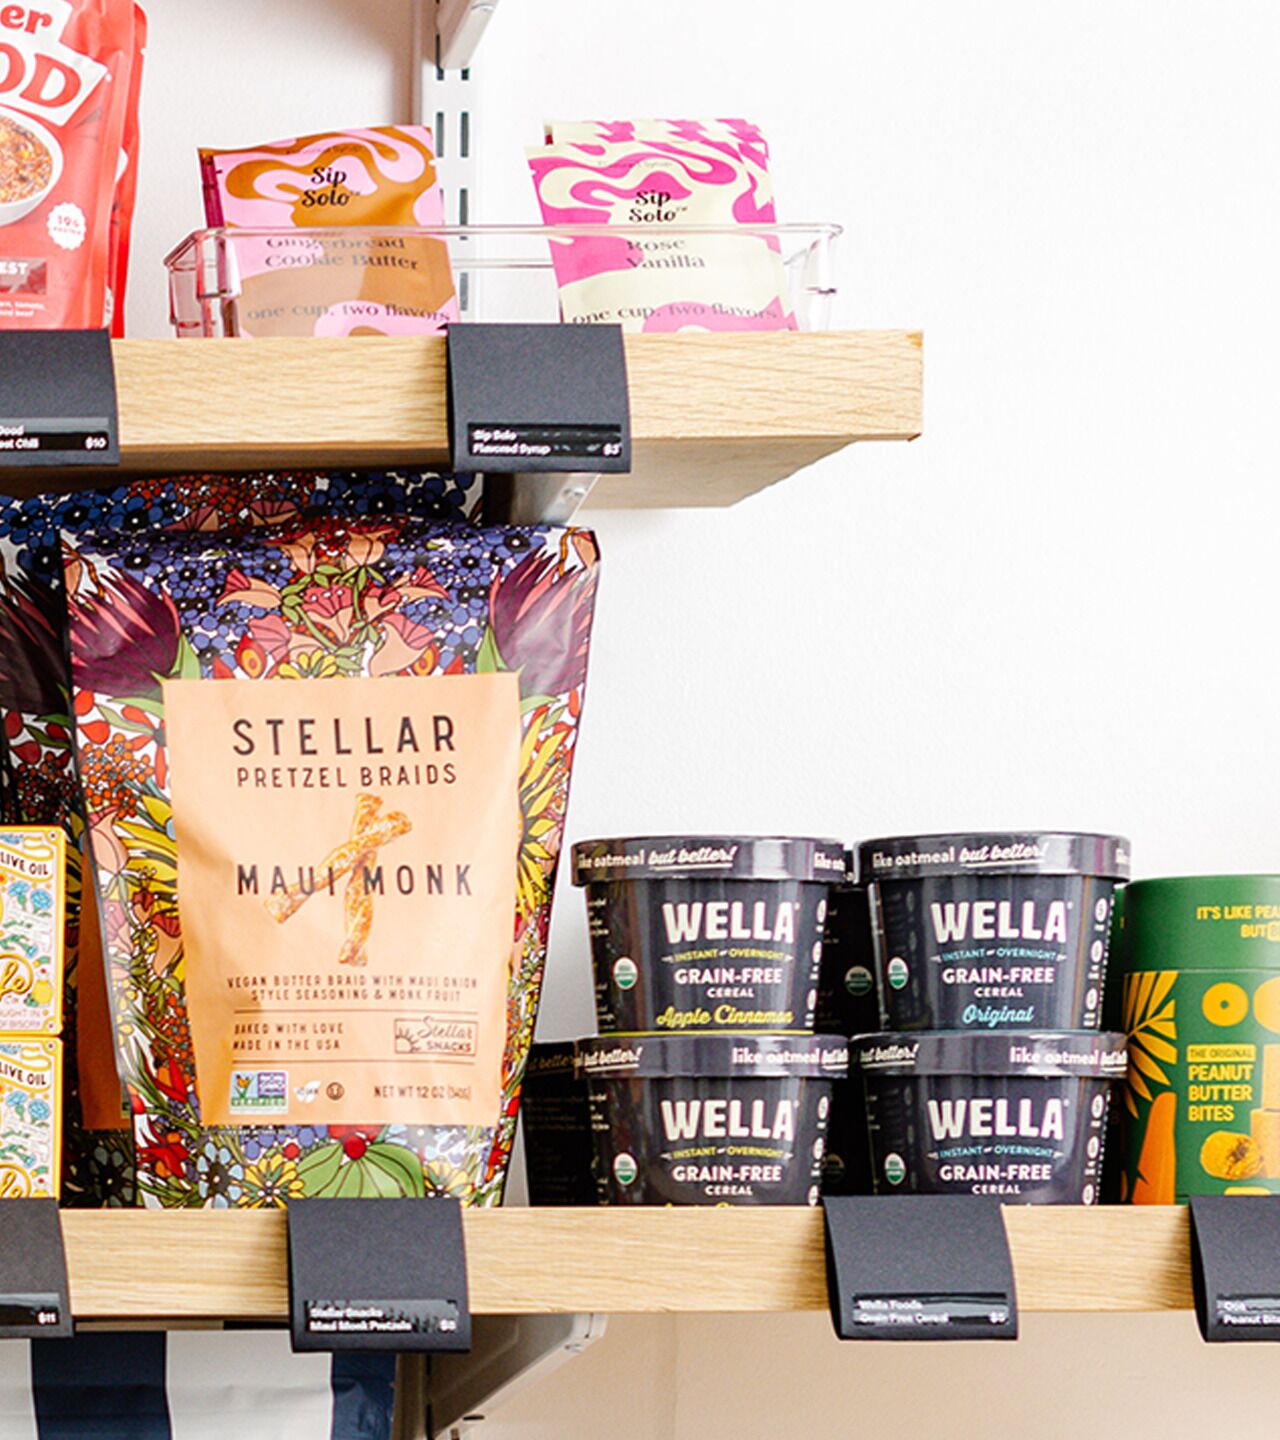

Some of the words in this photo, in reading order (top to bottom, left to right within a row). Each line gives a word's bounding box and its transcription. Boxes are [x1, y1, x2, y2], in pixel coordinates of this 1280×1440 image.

[233, 715, 456, 756] STELLAR
[237, 767, 347, 788] PRETZEL
[361, 764, 458, 787] BRAIDS
[29, 860, 48, 876] OIL
[237, 865, 334, 896] MAUI
[364, 865, 472, 896] MONK
[662, 902, 794, 943] WELLA
[931, 902, 1066, 944] WELLA
[675, 968, 782, 984] GRAIN-FREE
[942, 967, 1054, 985] GRAIN-FREE
[975, 987, 1023, 998] CEREAL
[1188, 1064, 1252, 1081] PEANUT
[1188, 1084, 1252, 1101] BUTTER
[1188, 1105, 1235, 1122] BITES
